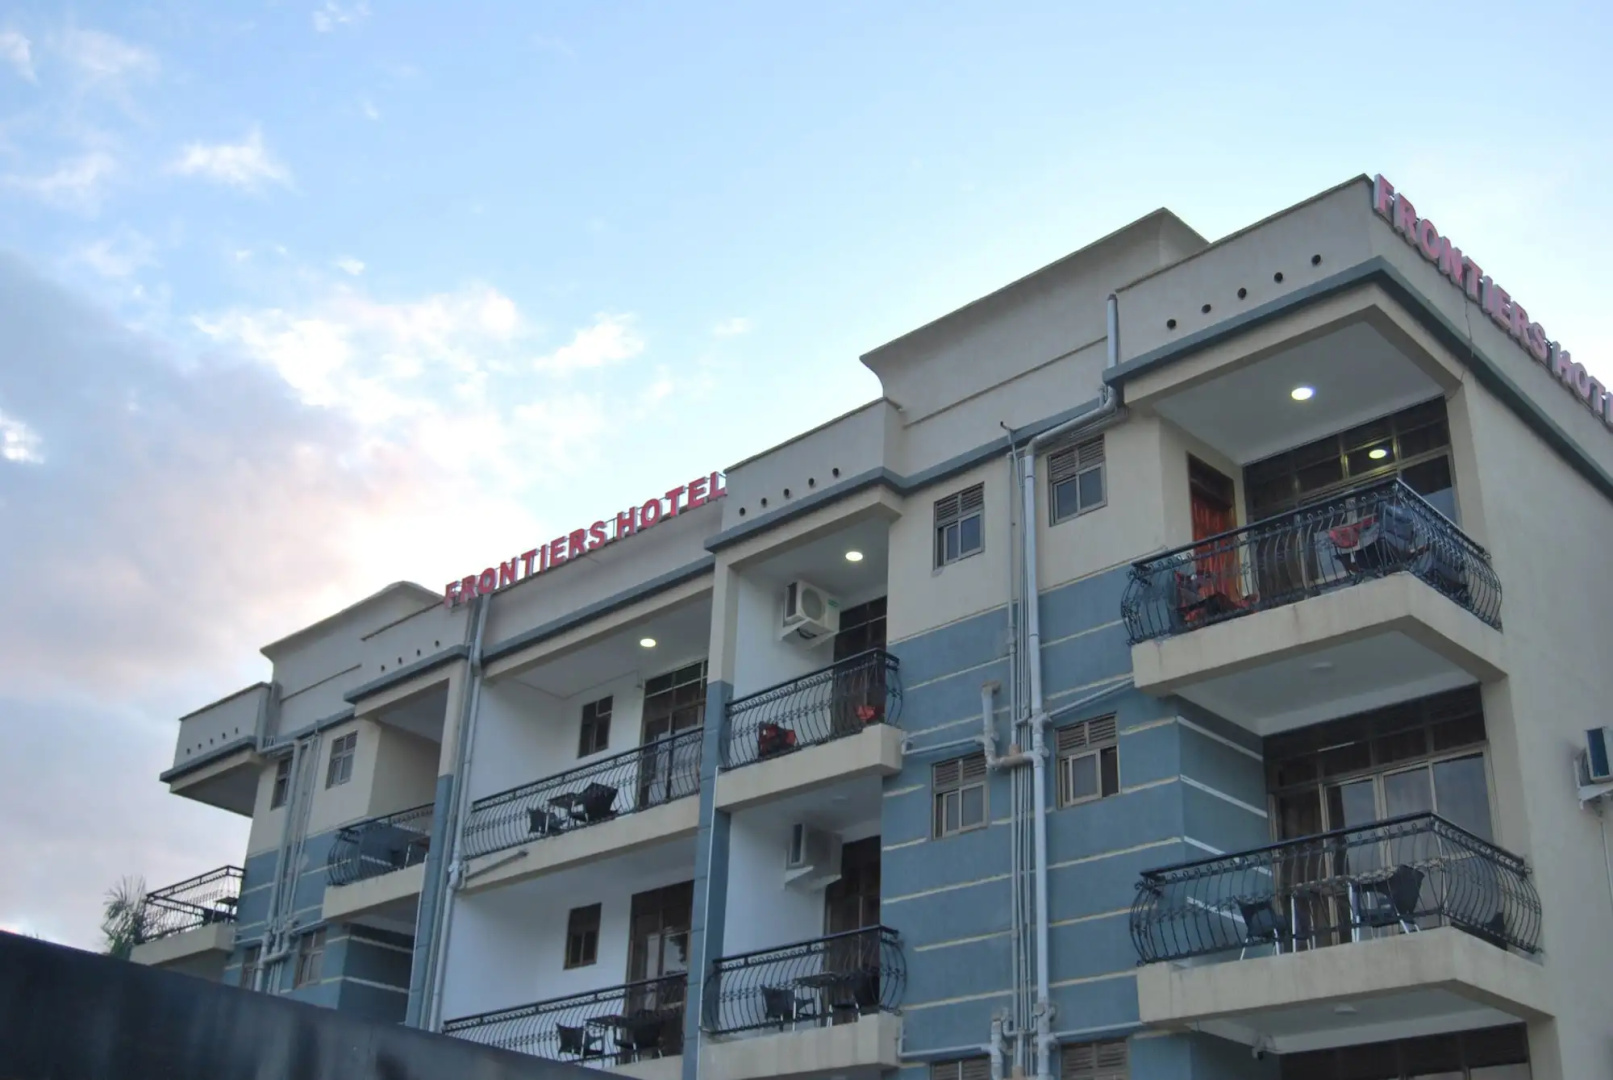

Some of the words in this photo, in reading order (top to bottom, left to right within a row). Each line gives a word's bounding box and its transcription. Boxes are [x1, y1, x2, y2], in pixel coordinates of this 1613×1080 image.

[1373, 173, 1548, 364] FRONTIERS
[444, 520, 608, 608] FRONTIERS
[616, 471, 728, 540] HOTEL
